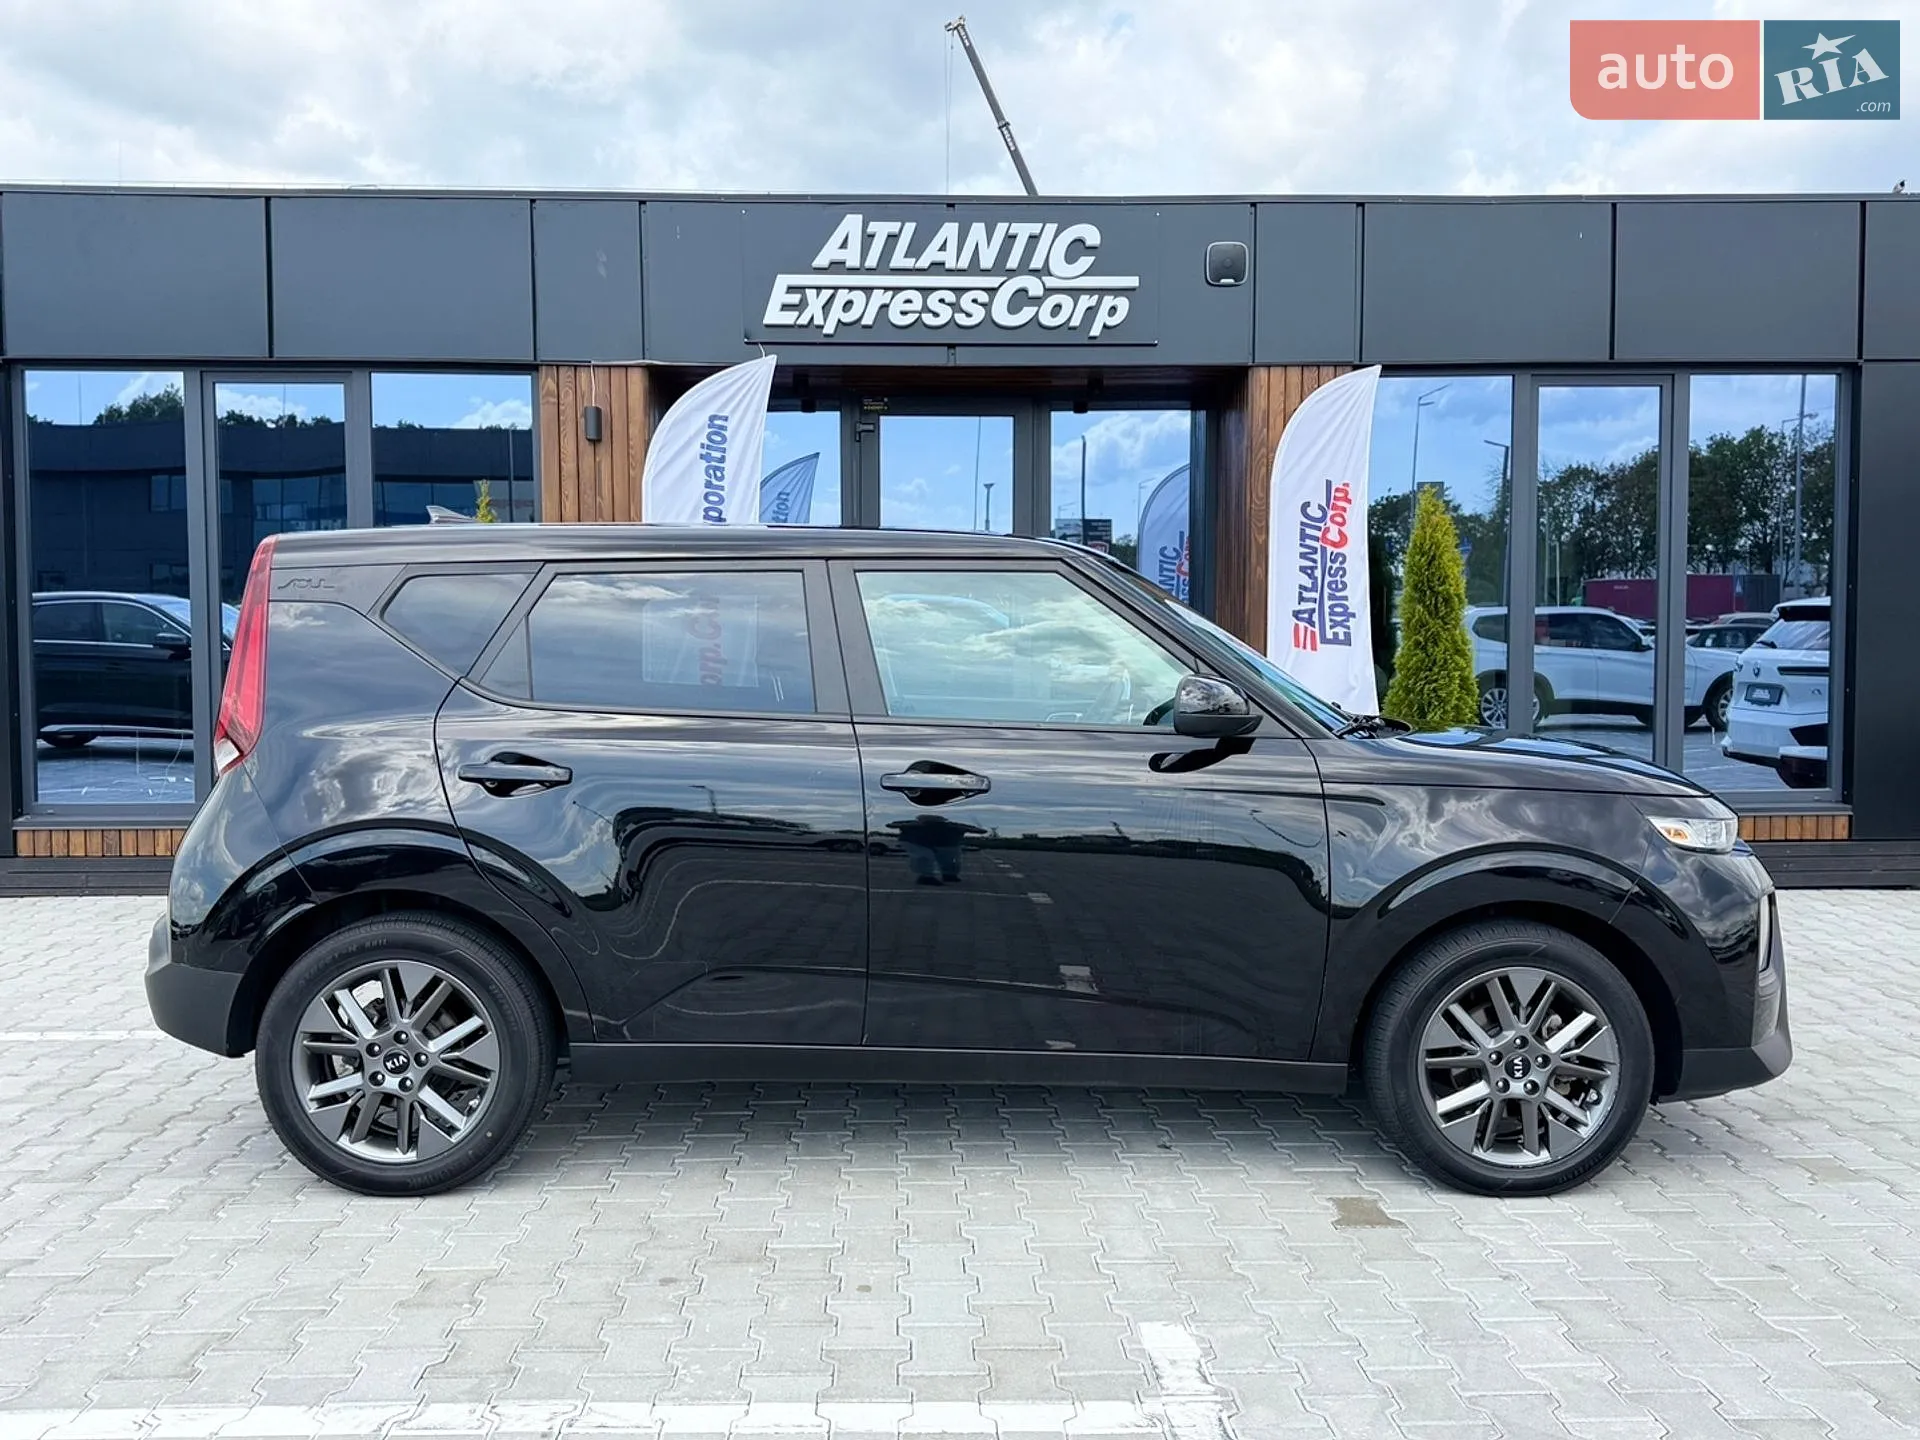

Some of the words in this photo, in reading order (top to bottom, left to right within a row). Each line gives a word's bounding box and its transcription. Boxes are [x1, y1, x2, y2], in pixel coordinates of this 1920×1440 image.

[812, 214, 1101, 279] ATLANTIC
[1292, 500, 1328, 630] ATLANTIC
[385, 1054, 408, 1070] KIA
[1513, 1057, 1523, 1078] KIA
